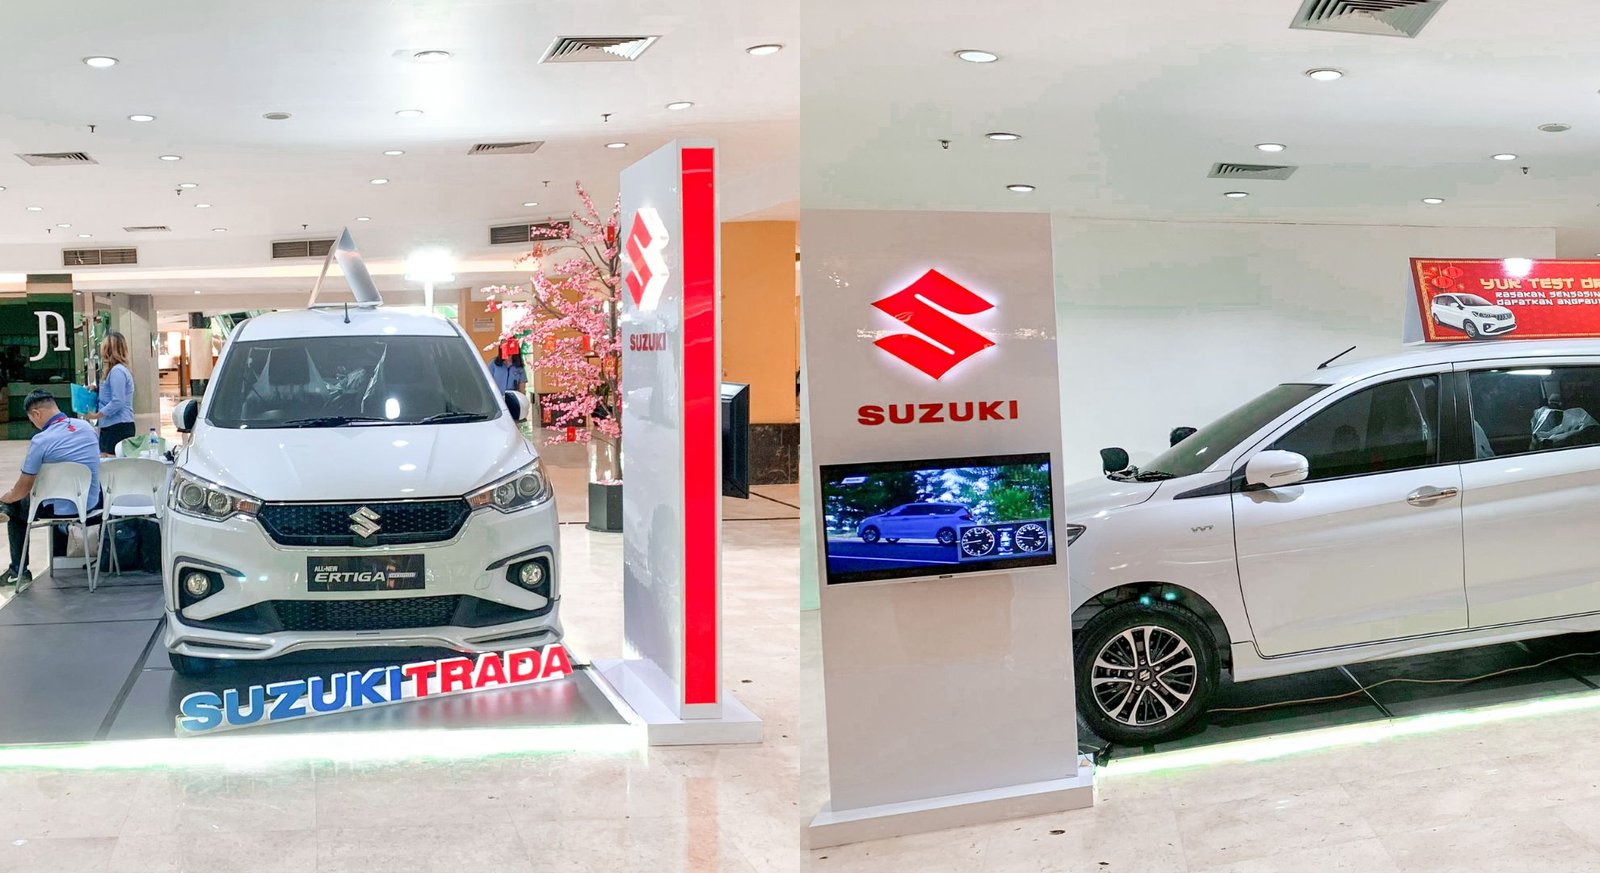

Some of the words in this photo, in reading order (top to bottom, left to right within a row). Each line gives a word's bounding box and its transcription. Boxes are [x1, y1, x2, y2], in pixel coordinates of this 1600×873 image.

[1527, 277, 1575, 290] TEST
[630, 332, 666, 351] SUZUKI
[857, 400, 1019, 426] SUZUKI
[314, 565, 338, 573] ALL-NEW
[314, 571, 386, 583] ERTIGA
